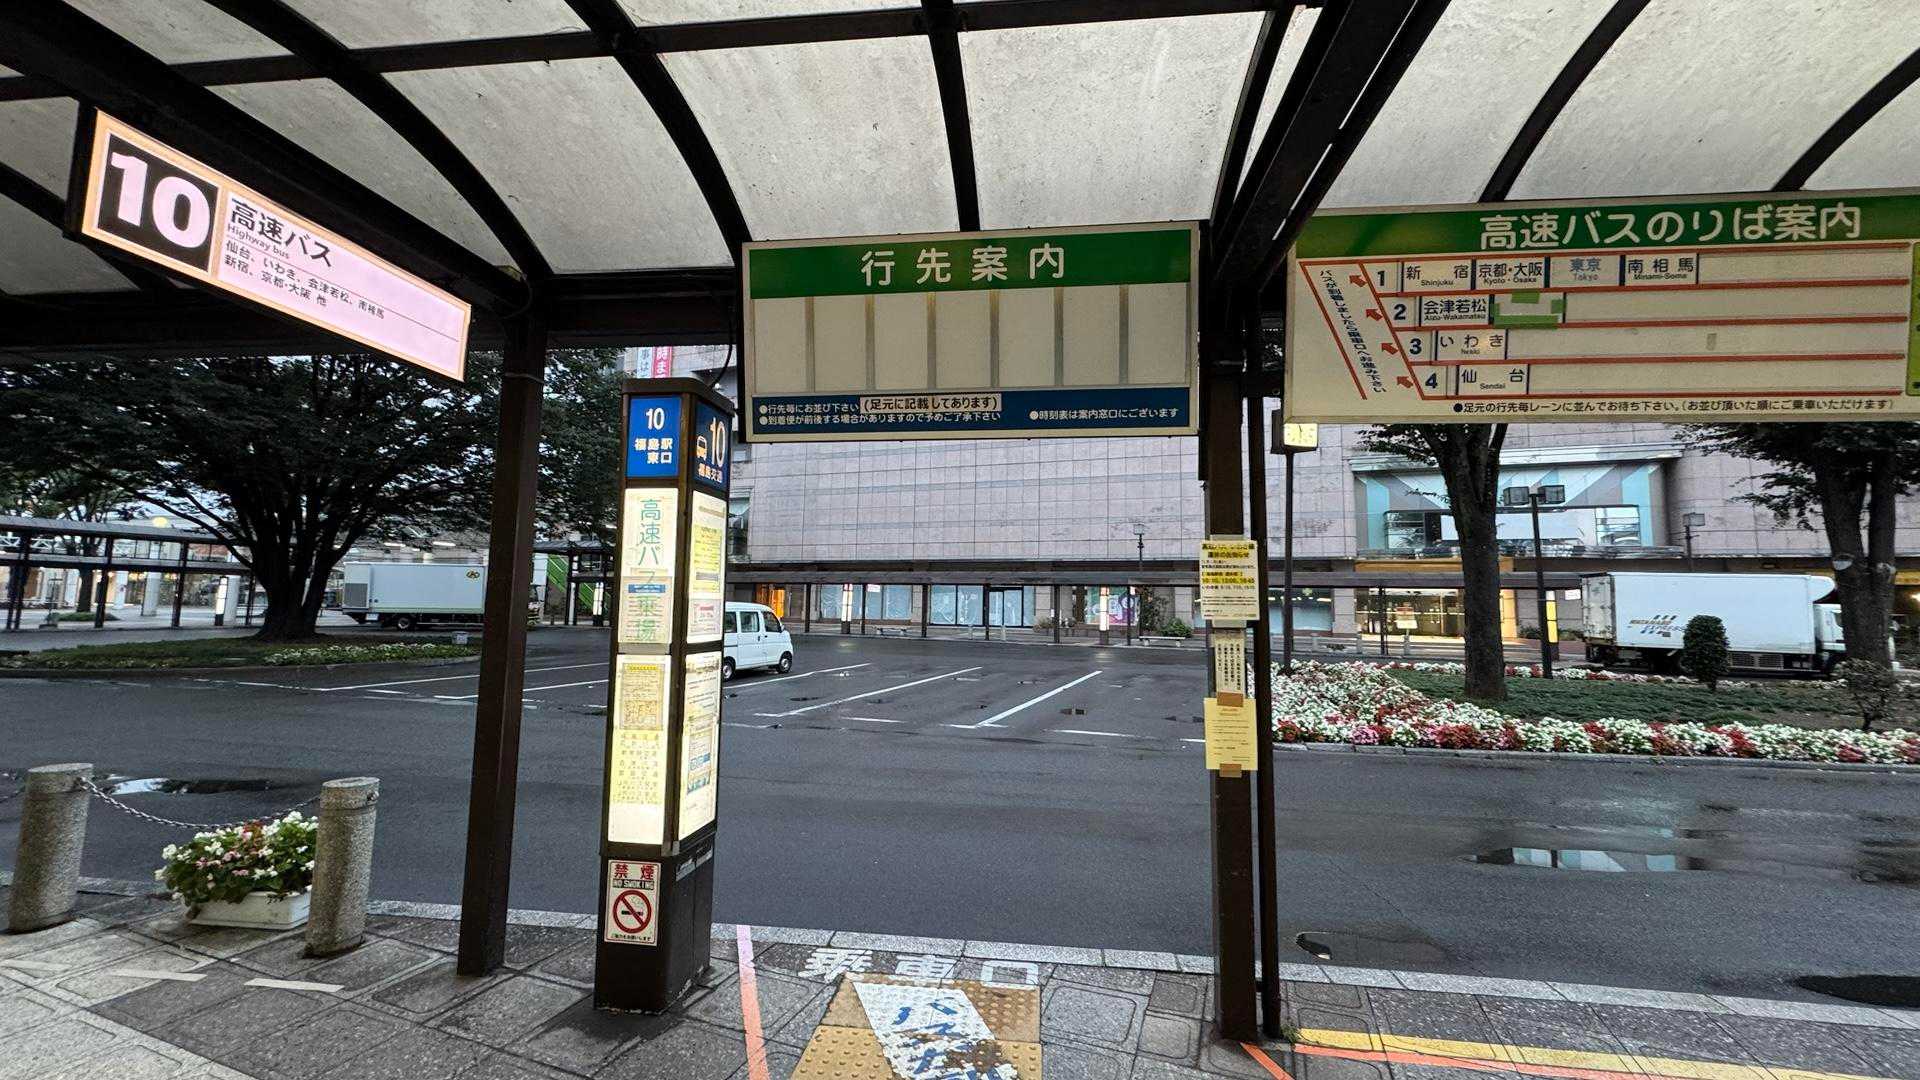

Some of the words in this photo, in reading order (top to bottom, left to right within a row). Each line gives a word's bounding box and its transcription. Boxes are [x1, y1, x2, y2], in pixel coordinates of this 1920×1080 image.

[111, 152, 210, 248] 10
[231, 198, 331, 267] 高速バス
[1479, 201, 1861, 250] 高速バスのりば案内
[227, 223, 271, 251] Highway
[273, 245, 290, 260] bus
[860, 242, 1065, 286] 行先案内
[1406, 263, 1469, 280] 新宿
[1479, 261, 1543, 277] 京都・大阪
[1569, 257, 1601, 272] 東京
[1627, 257, 1694, 274] 南相馬
[1377, 270, 1386, 286] 1
[1420, 279, 1454, 287] Shinjuku
[1573, 273, 1599, 282] Tokyo
[1393, 303, 1407, 321] 2
[1424, 298, 1487, 315] 会津若松
[1409, 337, 1422, 355] 3
[1440, 334, 1504, 348] いわき
[1425, 372, 1438, 389] 4
[1461, 367, 1525, 383] 仙台
[1479, 382, 1506, 390] Sendai
[646, 408, 665, 430] 10
[710, 417, 725, 467] 10
[647, 452, 672, 464] 東口
[614, 863, 655, 880] 禁煙
[613, 880, 623, 888] NO
[624, 880, 655, 890] SMOKING
